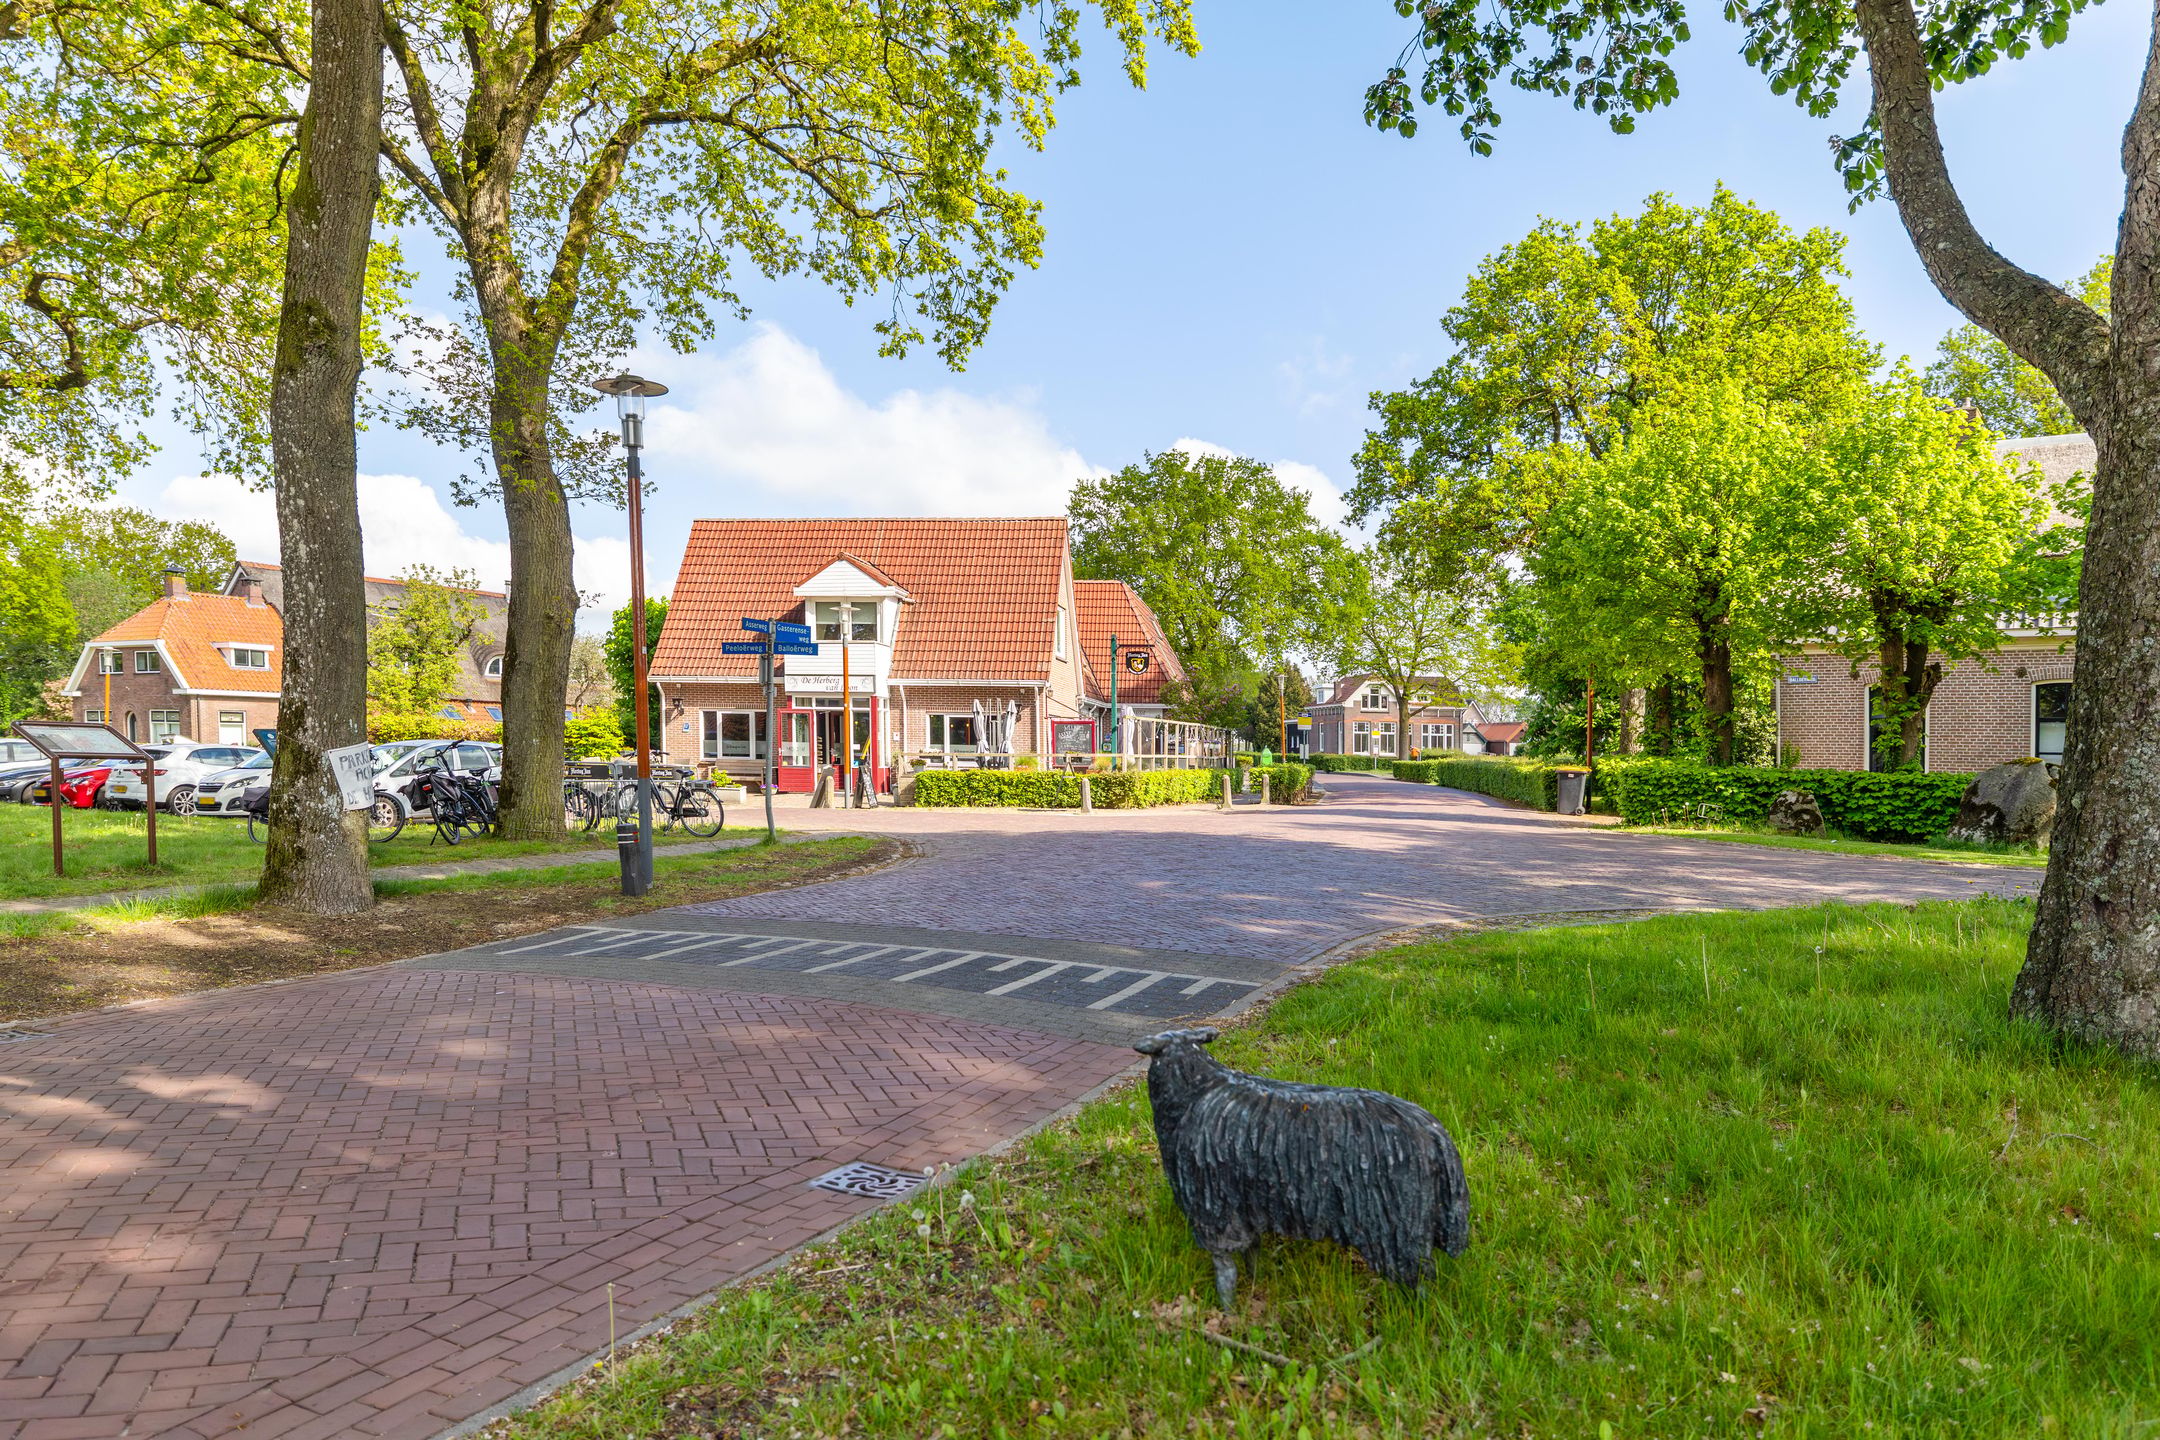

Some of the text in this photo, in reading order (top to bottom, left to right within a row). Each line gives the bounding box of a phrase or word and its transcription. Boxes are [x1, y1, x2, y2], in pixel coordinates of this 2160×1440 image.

[745, 620, 768, 632] Asserweg
[798, 636, 810, 644] weg
[725, 644, 763, 653] Peeloërweg
[777, 644, 813, 654] Balloërweg
[801, 676, 840, 686] De Herberg
